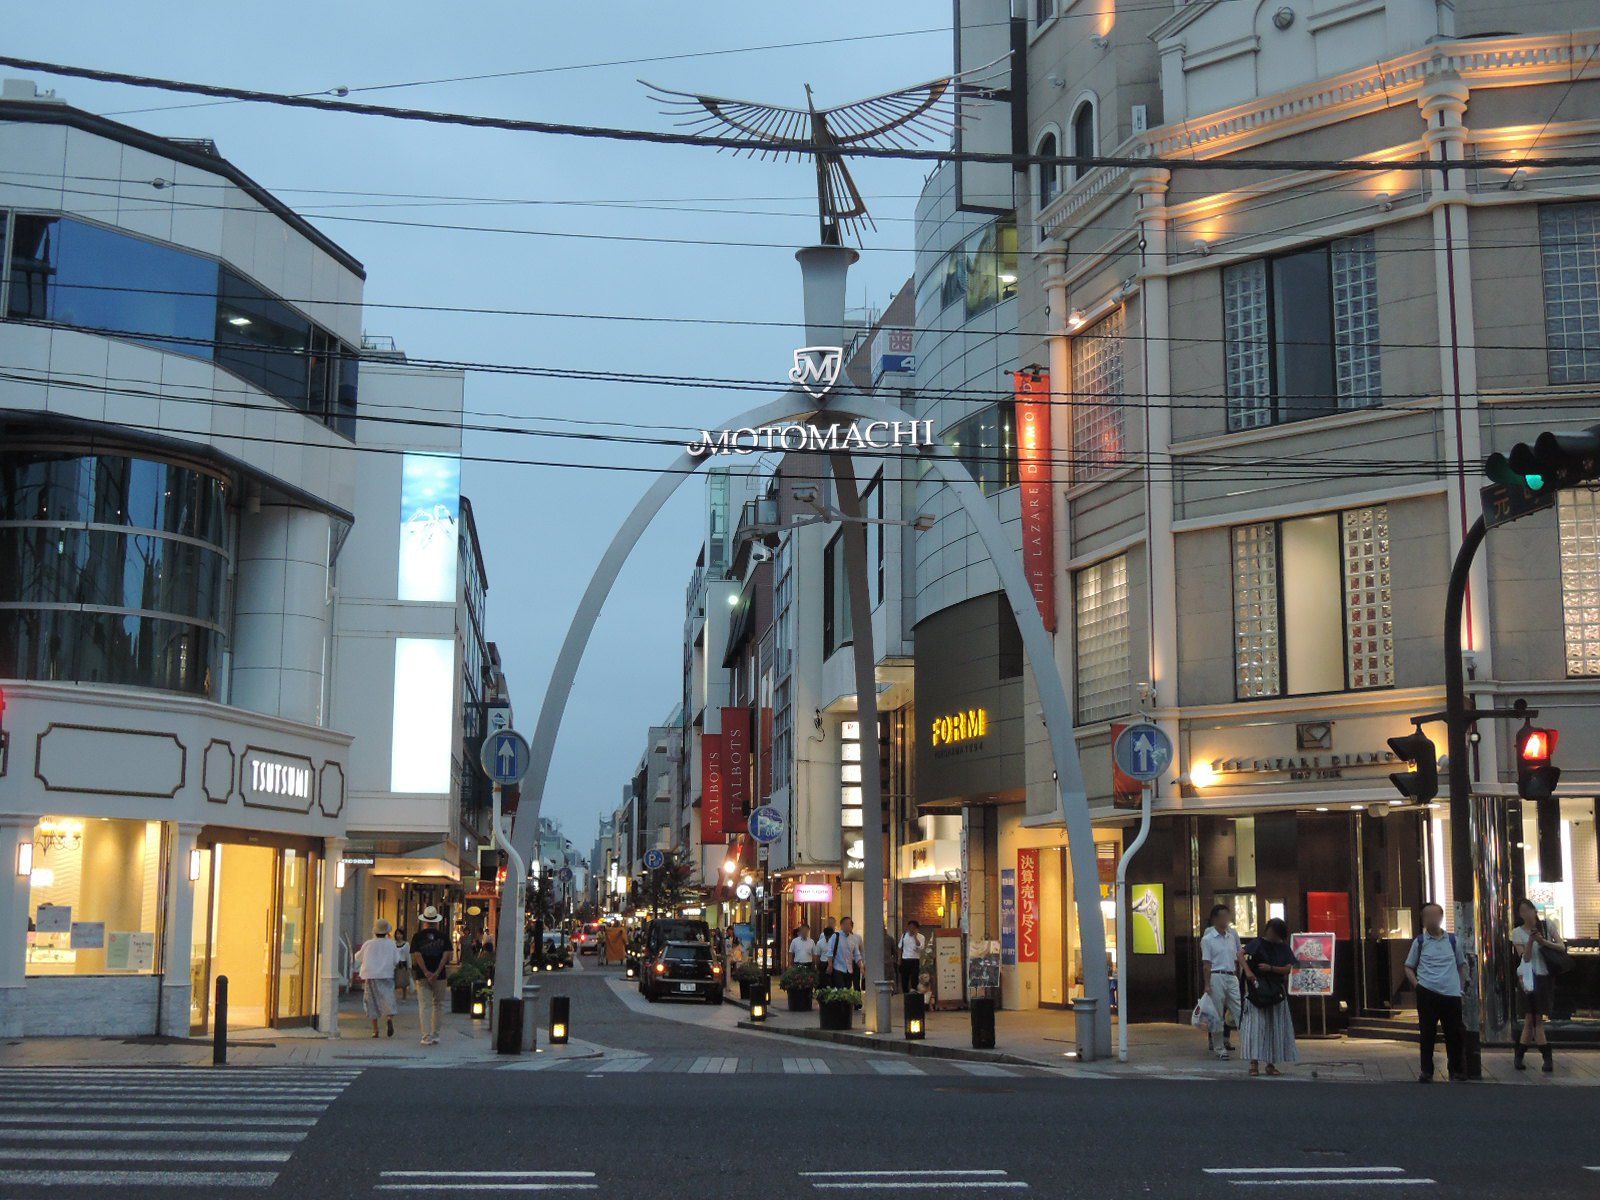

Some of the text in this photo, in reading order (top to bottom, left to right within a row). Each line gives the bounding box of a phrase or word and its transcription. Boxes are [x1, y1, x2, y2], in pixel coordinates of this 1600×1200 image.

[686, 419, 934, 457] MOTOMACHI
[1029, 488, 1042, 556] LAZARE
[932, 708, 987, 746] FORM
[252, 760, 309, 798] TSUTSUMI
[709, 752, 719, 826] TALBOTS
[731, 729, 741, 814] TALBOTS
[1021, 855, 1035, 957] 決算売り尽くし
